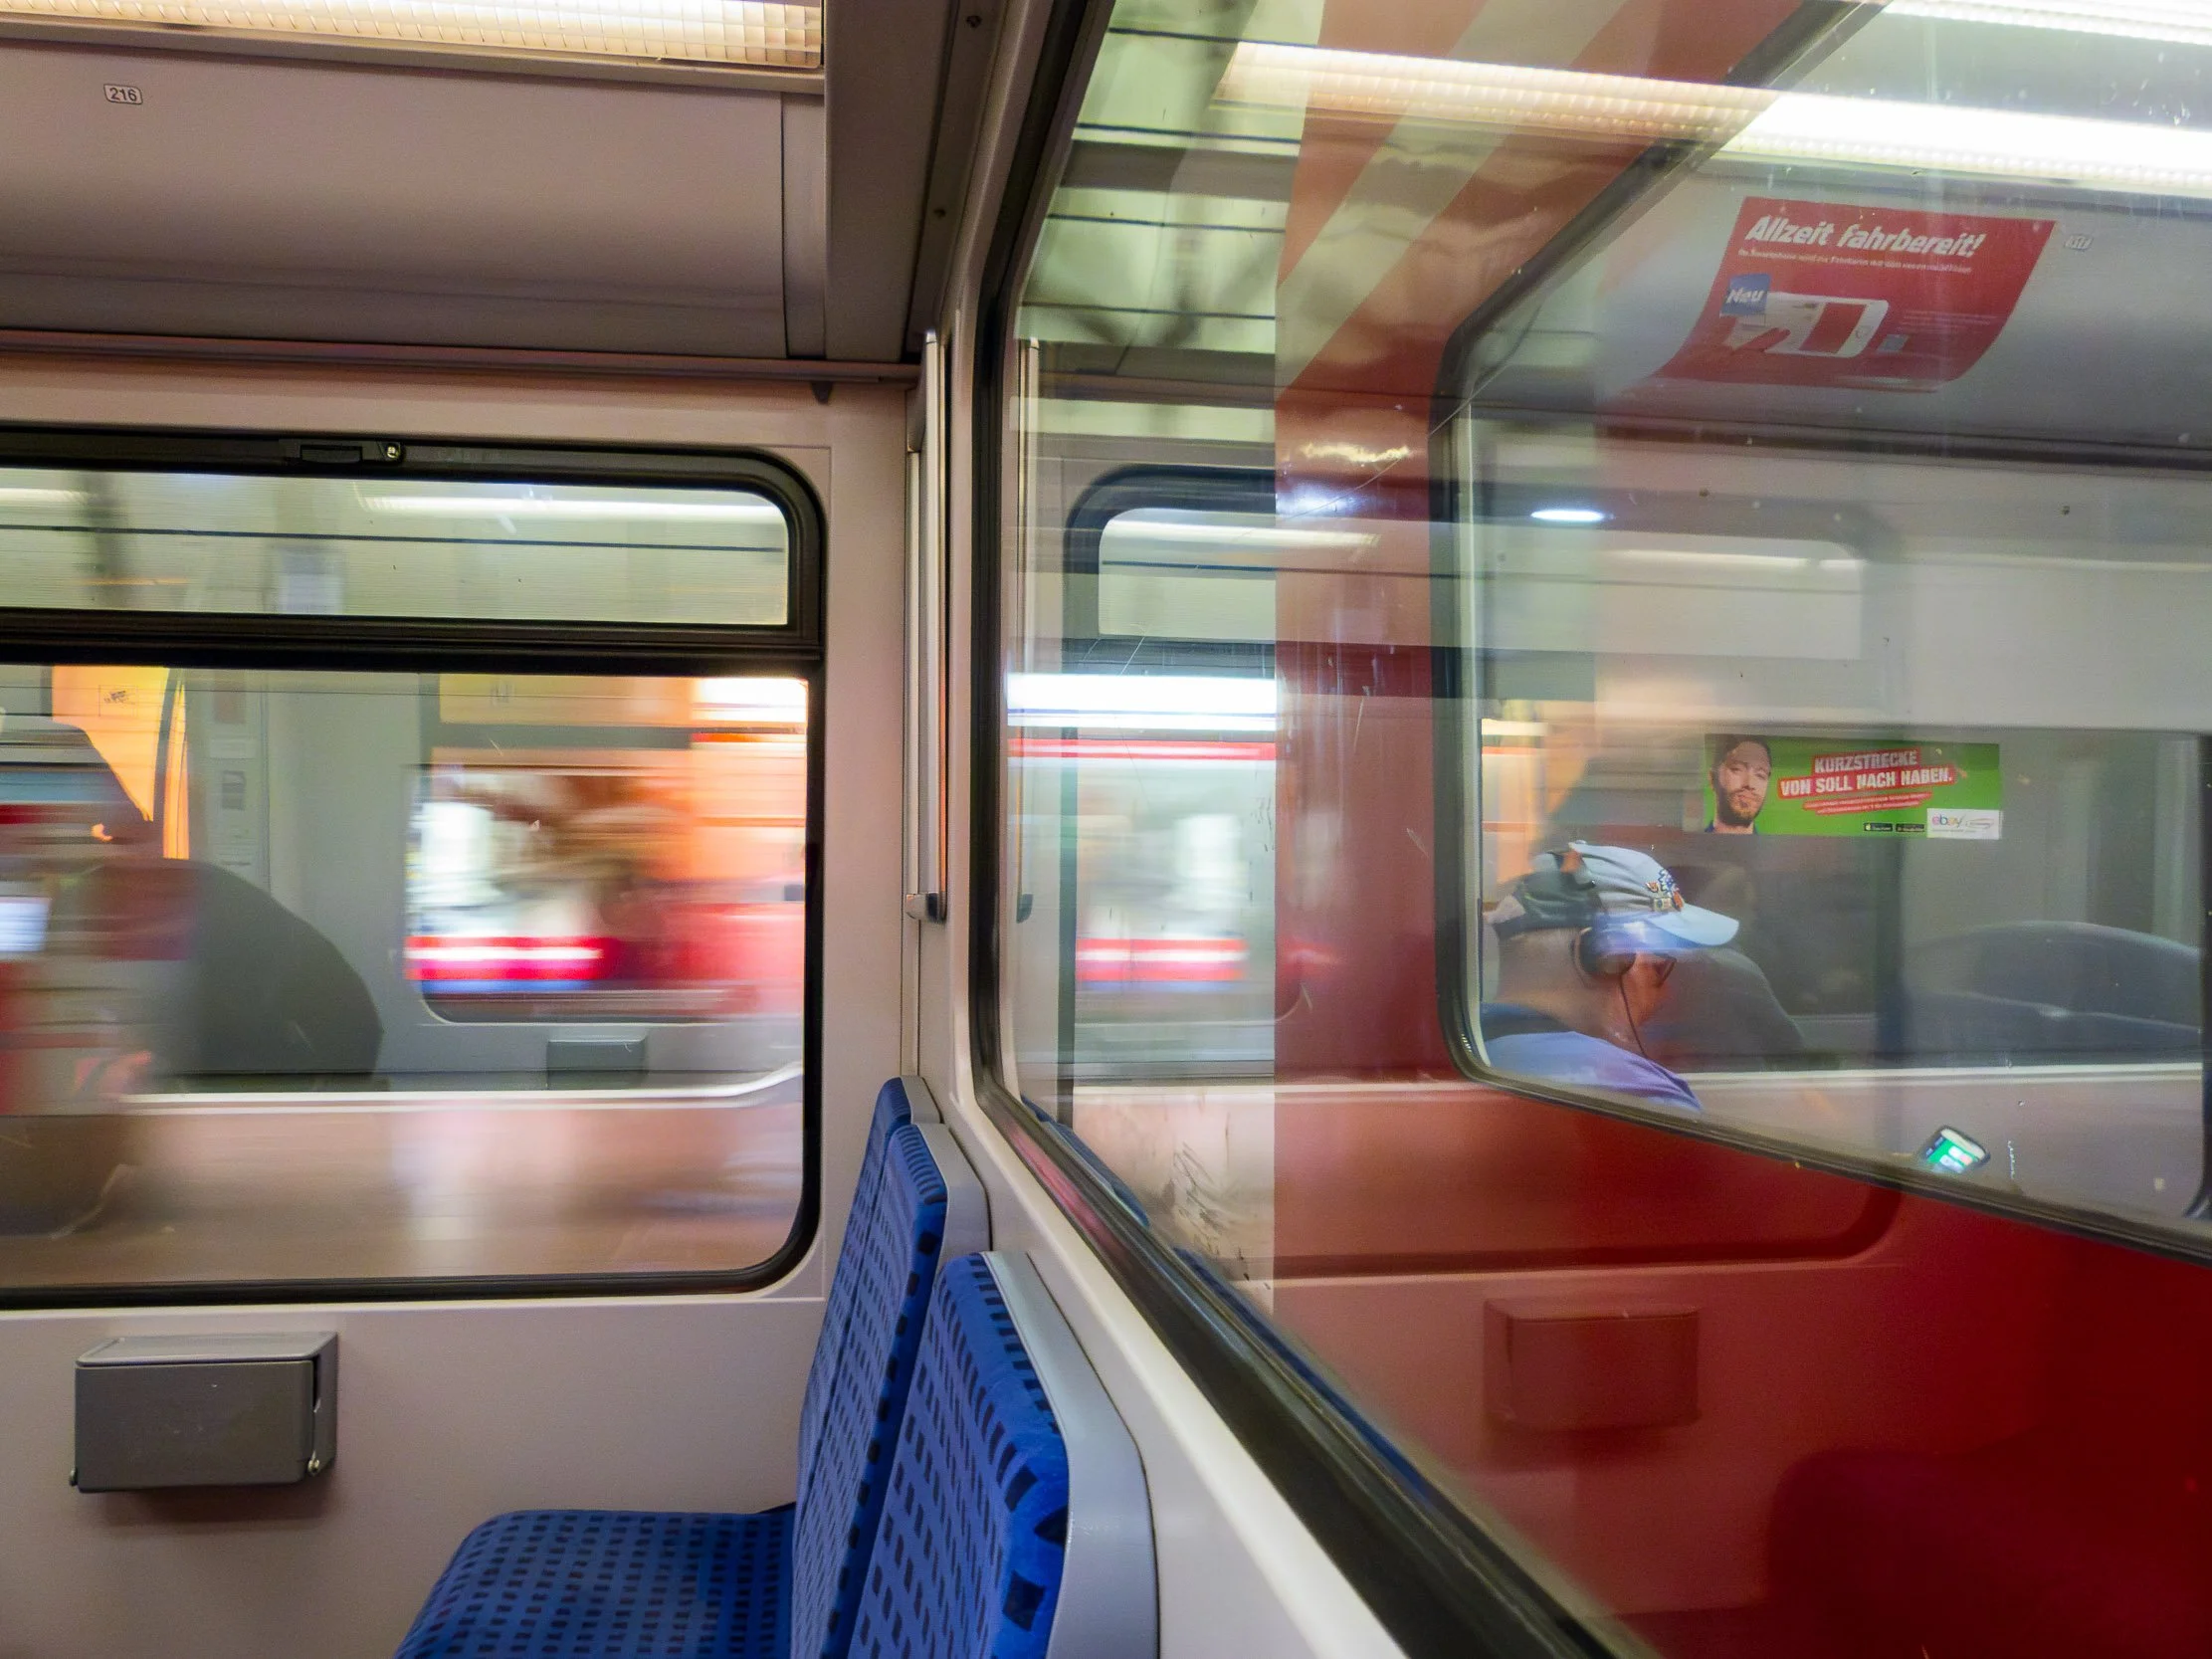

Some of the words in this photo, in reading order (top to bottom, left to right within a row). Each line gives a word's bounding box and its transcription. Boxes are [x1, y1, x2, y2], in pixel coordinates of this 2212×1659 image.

[109, 87, 137, 102] 216
[1744, 215, 1835, 246] Allzeit
[1836, 224, 1987, 258] fahrbereit!
[1814, 750, 1917, 773] KURZSTRECKE
[1780, 779, 1811, 796] VON
[1815, 775, 1853, 793] SOLL
[1857, 771, 1896, 789] NACH
[1901, 767, 1953, 785] HABEN.
[1931, 814, 1965, 828] ebay
